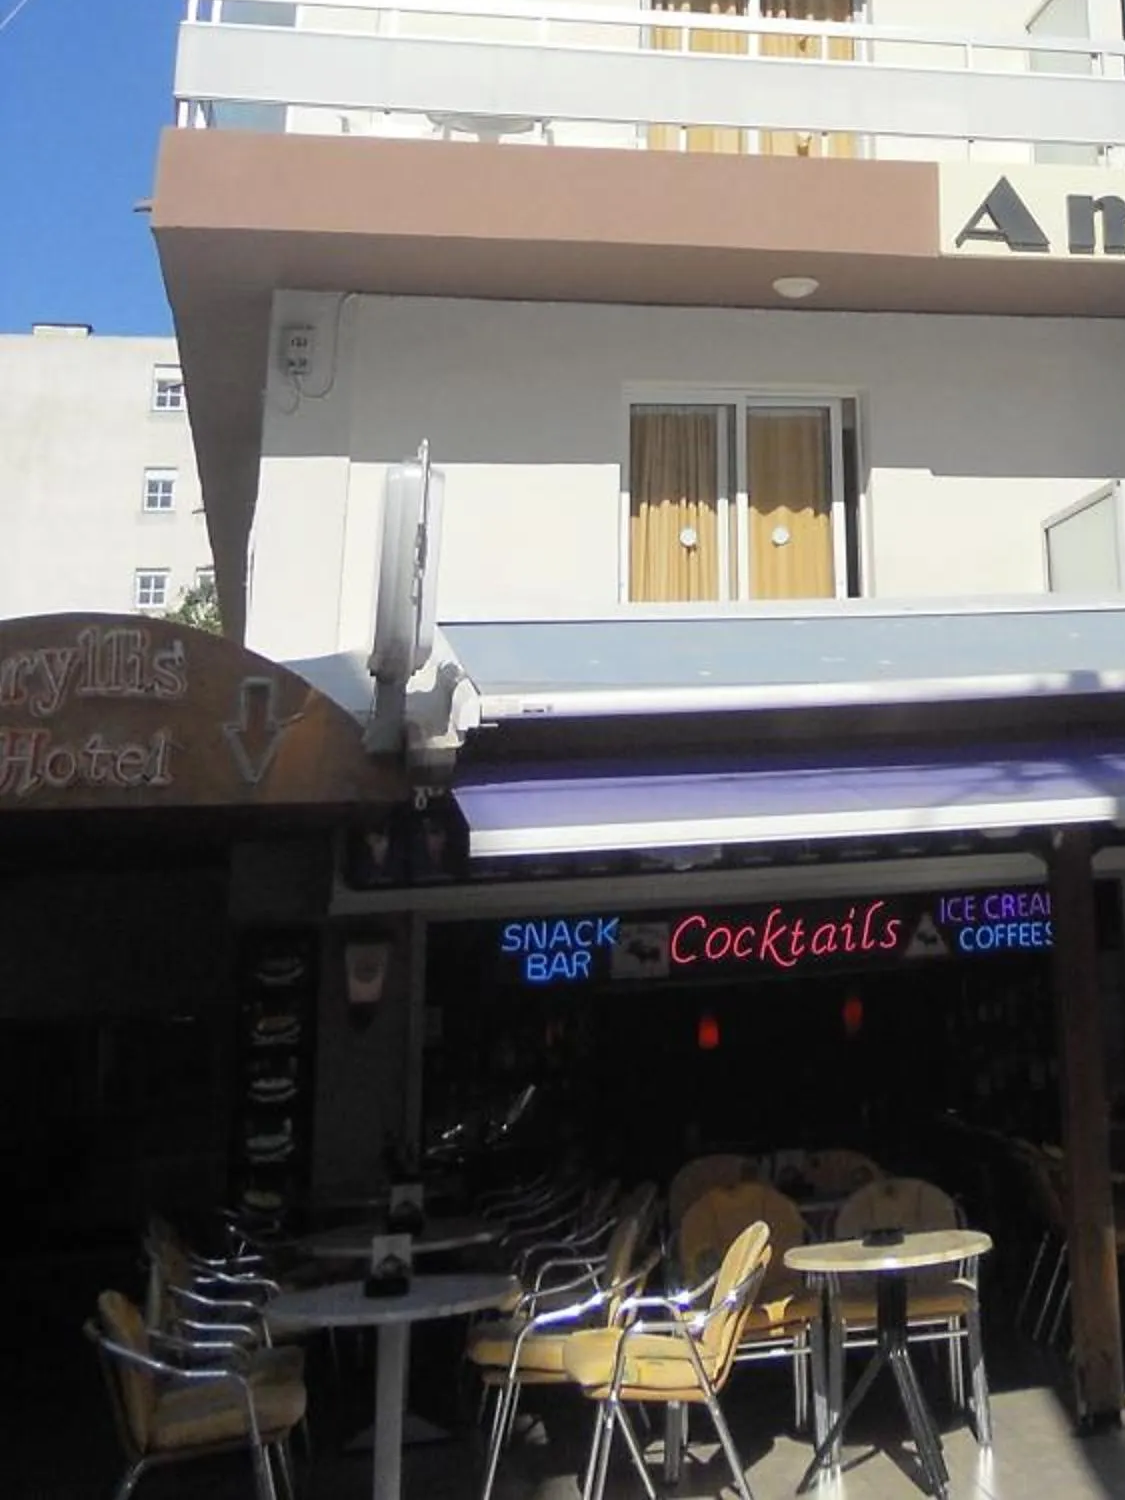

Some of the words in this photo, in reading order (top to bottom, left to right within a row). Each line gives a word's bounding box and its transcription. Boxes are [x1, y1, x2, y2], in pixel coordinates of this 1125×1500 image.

[0, 726, 175, 796] Hotel
[939, 894, 977, 924] ICE
[501, 917, 621, 953] SNACK
[670, 900, 901, 967] Cocktails
[525, 950, 592, 981] BAR
